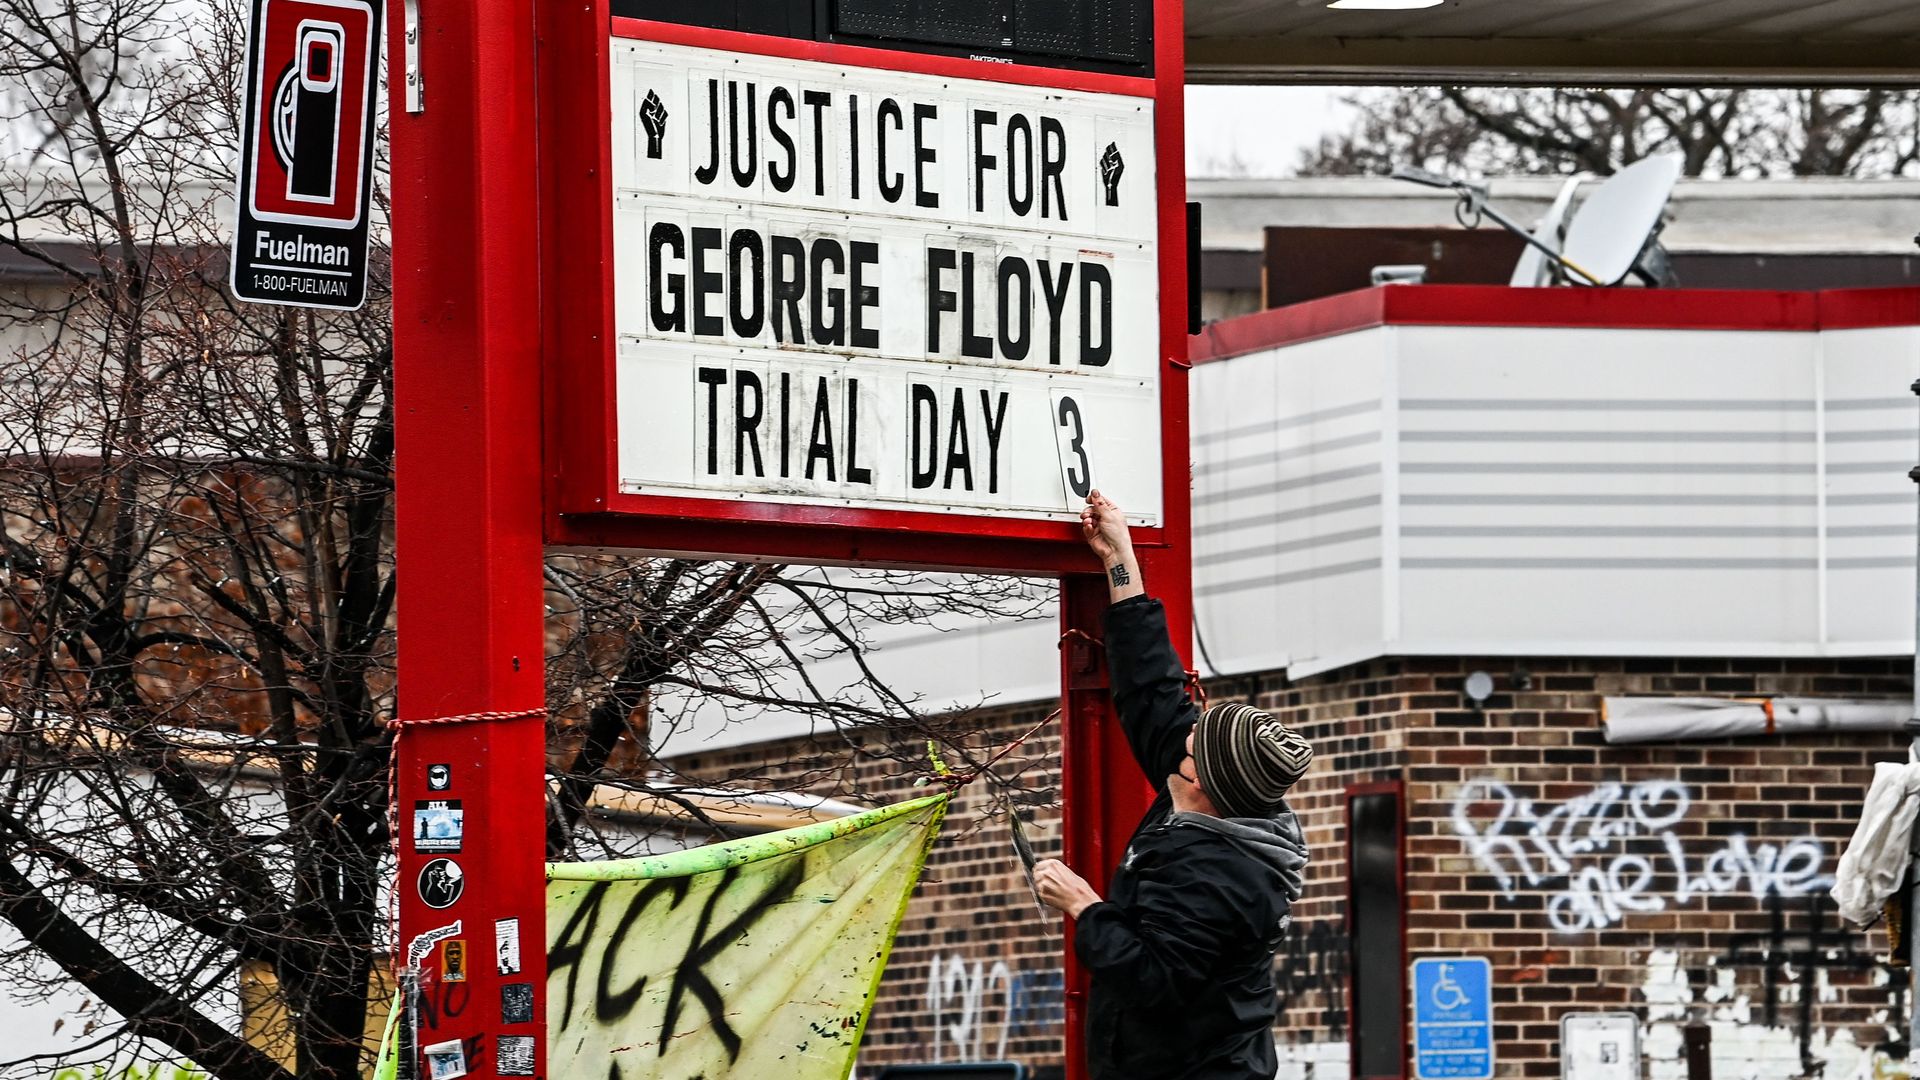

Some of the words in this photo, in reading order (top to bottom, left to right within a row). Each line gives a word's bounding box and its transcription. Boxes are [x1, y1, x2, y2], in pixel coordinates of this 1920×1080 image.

[694, 79, 939, 208] JUSTICE
[974, 109, 1068, 221] FOR
[253, 274, 348, 297] 1-800-FUELMAN
[255, 231, 349, 266] Fuelman
[649, 222, 880, 349] GEORGE
[927, 247, 1112, 367] FLOYD
[698, 367, 872, 484] TRIAL
[911, 383, 1009, 494] DAY
[1059, 396, 1091, 498] 3
